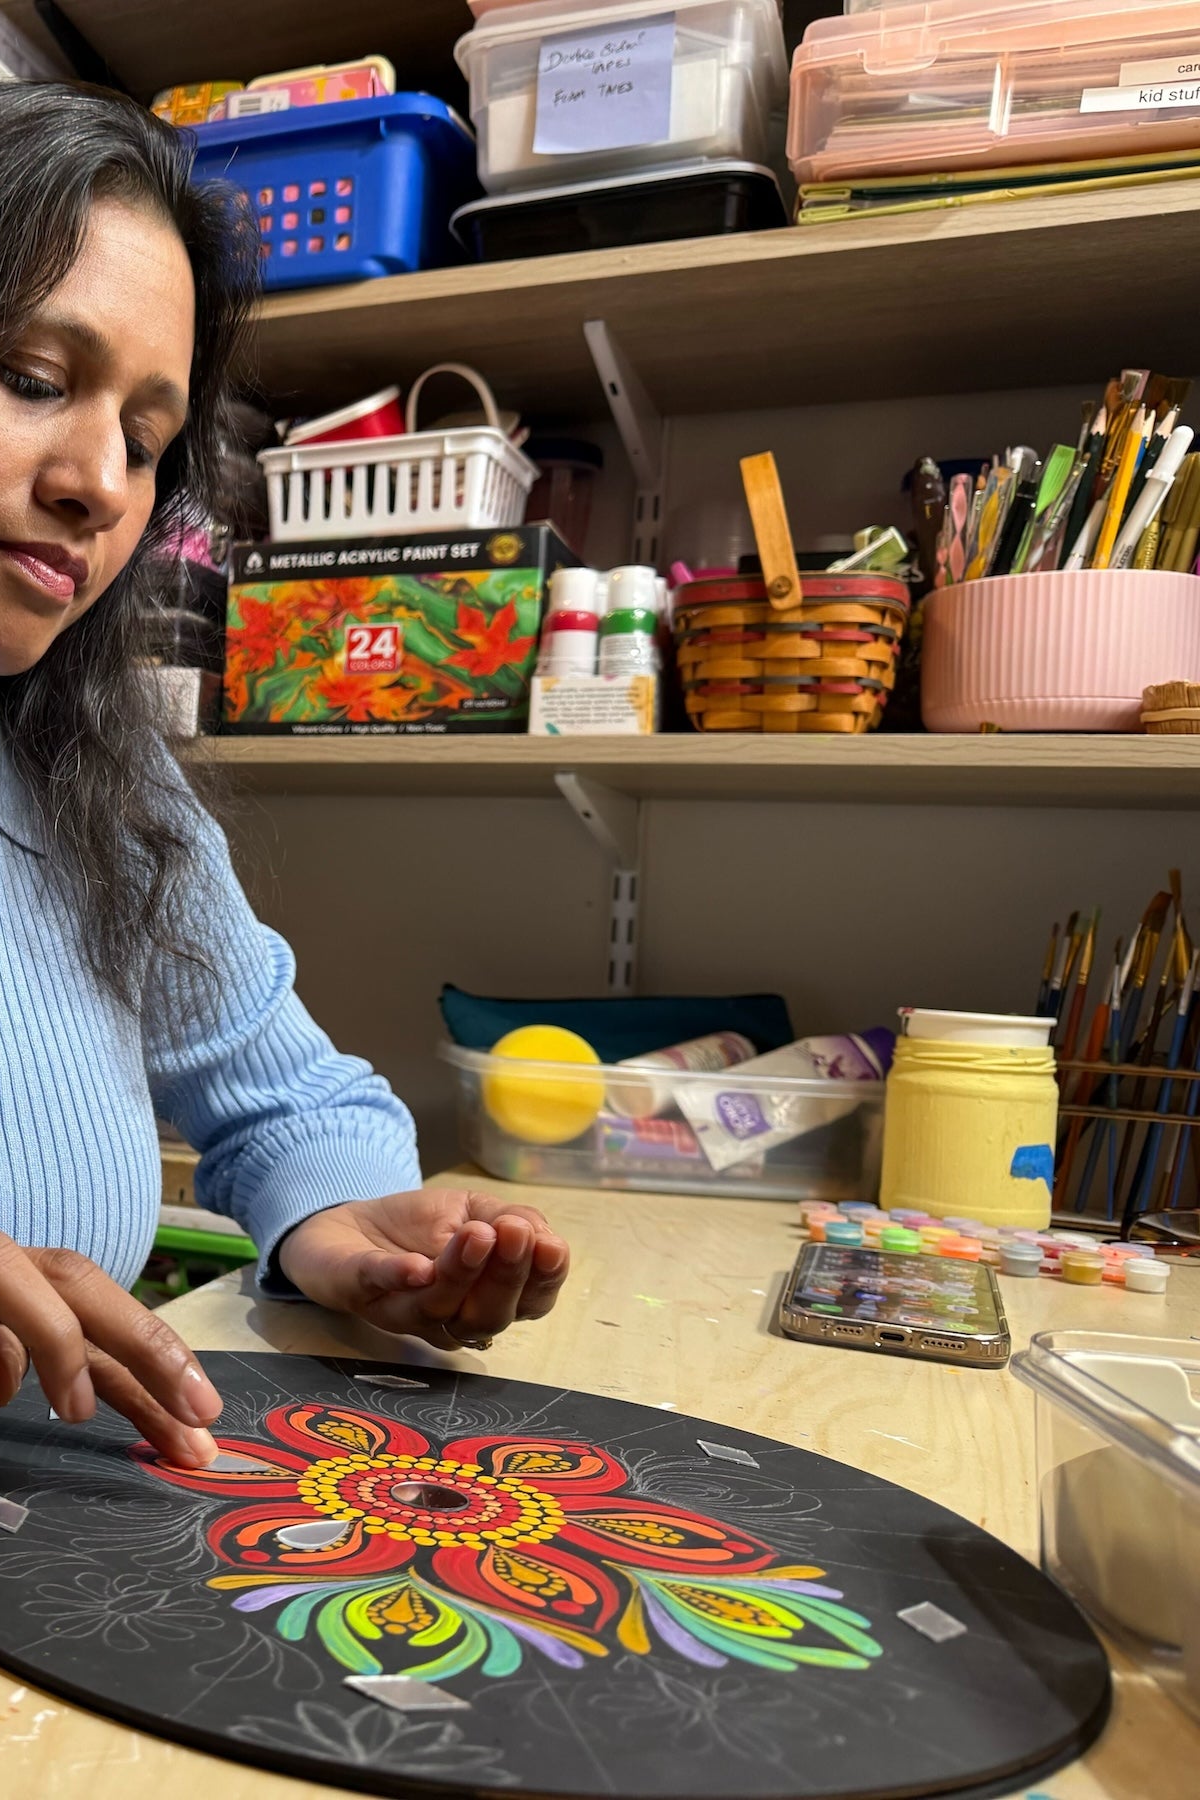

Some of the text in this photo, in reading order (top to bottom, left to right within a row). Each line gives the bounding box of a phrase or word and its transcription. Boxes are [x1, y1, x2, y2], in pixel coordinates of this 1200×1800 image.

[1138, 88, 1163, 103] kid
[269, 551, 337, 570] METALLIC
[337, 547, 400, 566] ACRYLIC
[402, 544, 449, 561] PAINT
[450, 542, 482, 559] SET
[349, 628, 397, 660] 24
